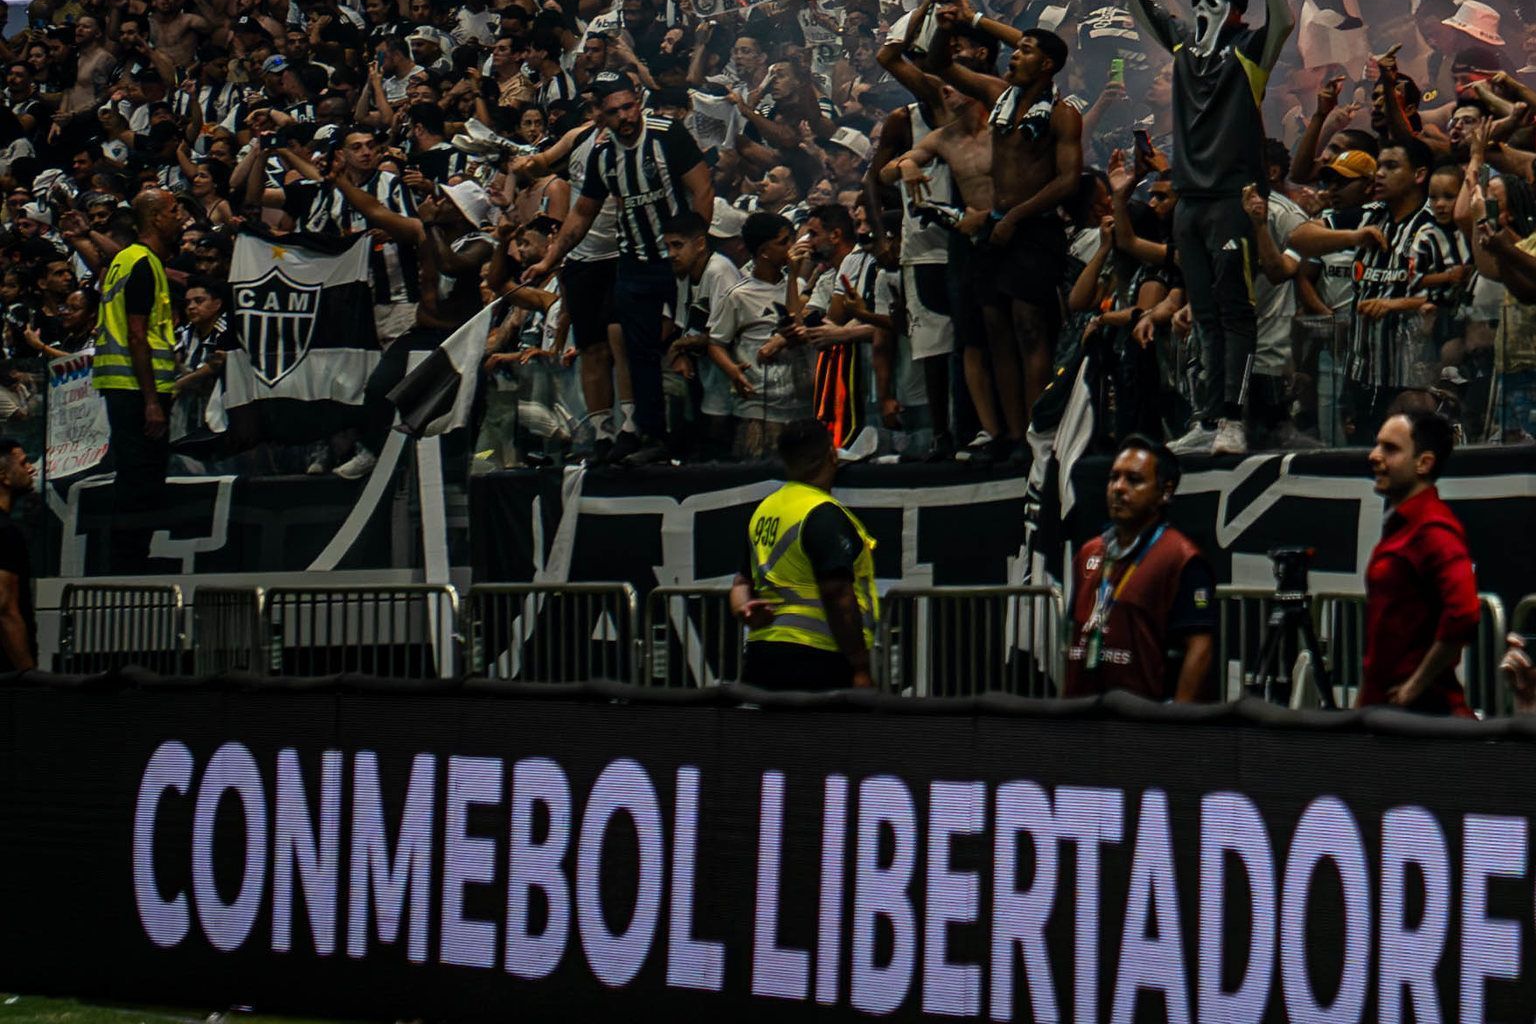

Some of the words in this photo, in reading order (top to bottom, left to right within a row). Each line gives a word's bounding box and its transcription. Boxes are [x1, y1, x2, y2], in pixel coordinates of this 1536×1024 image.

[1363, 266, 1408, 283] BETANO
[237, 288, 311, 312] CAM
[754, 516, 780, 547] 939
[134, 741, 725, 991] CONMEBOL
